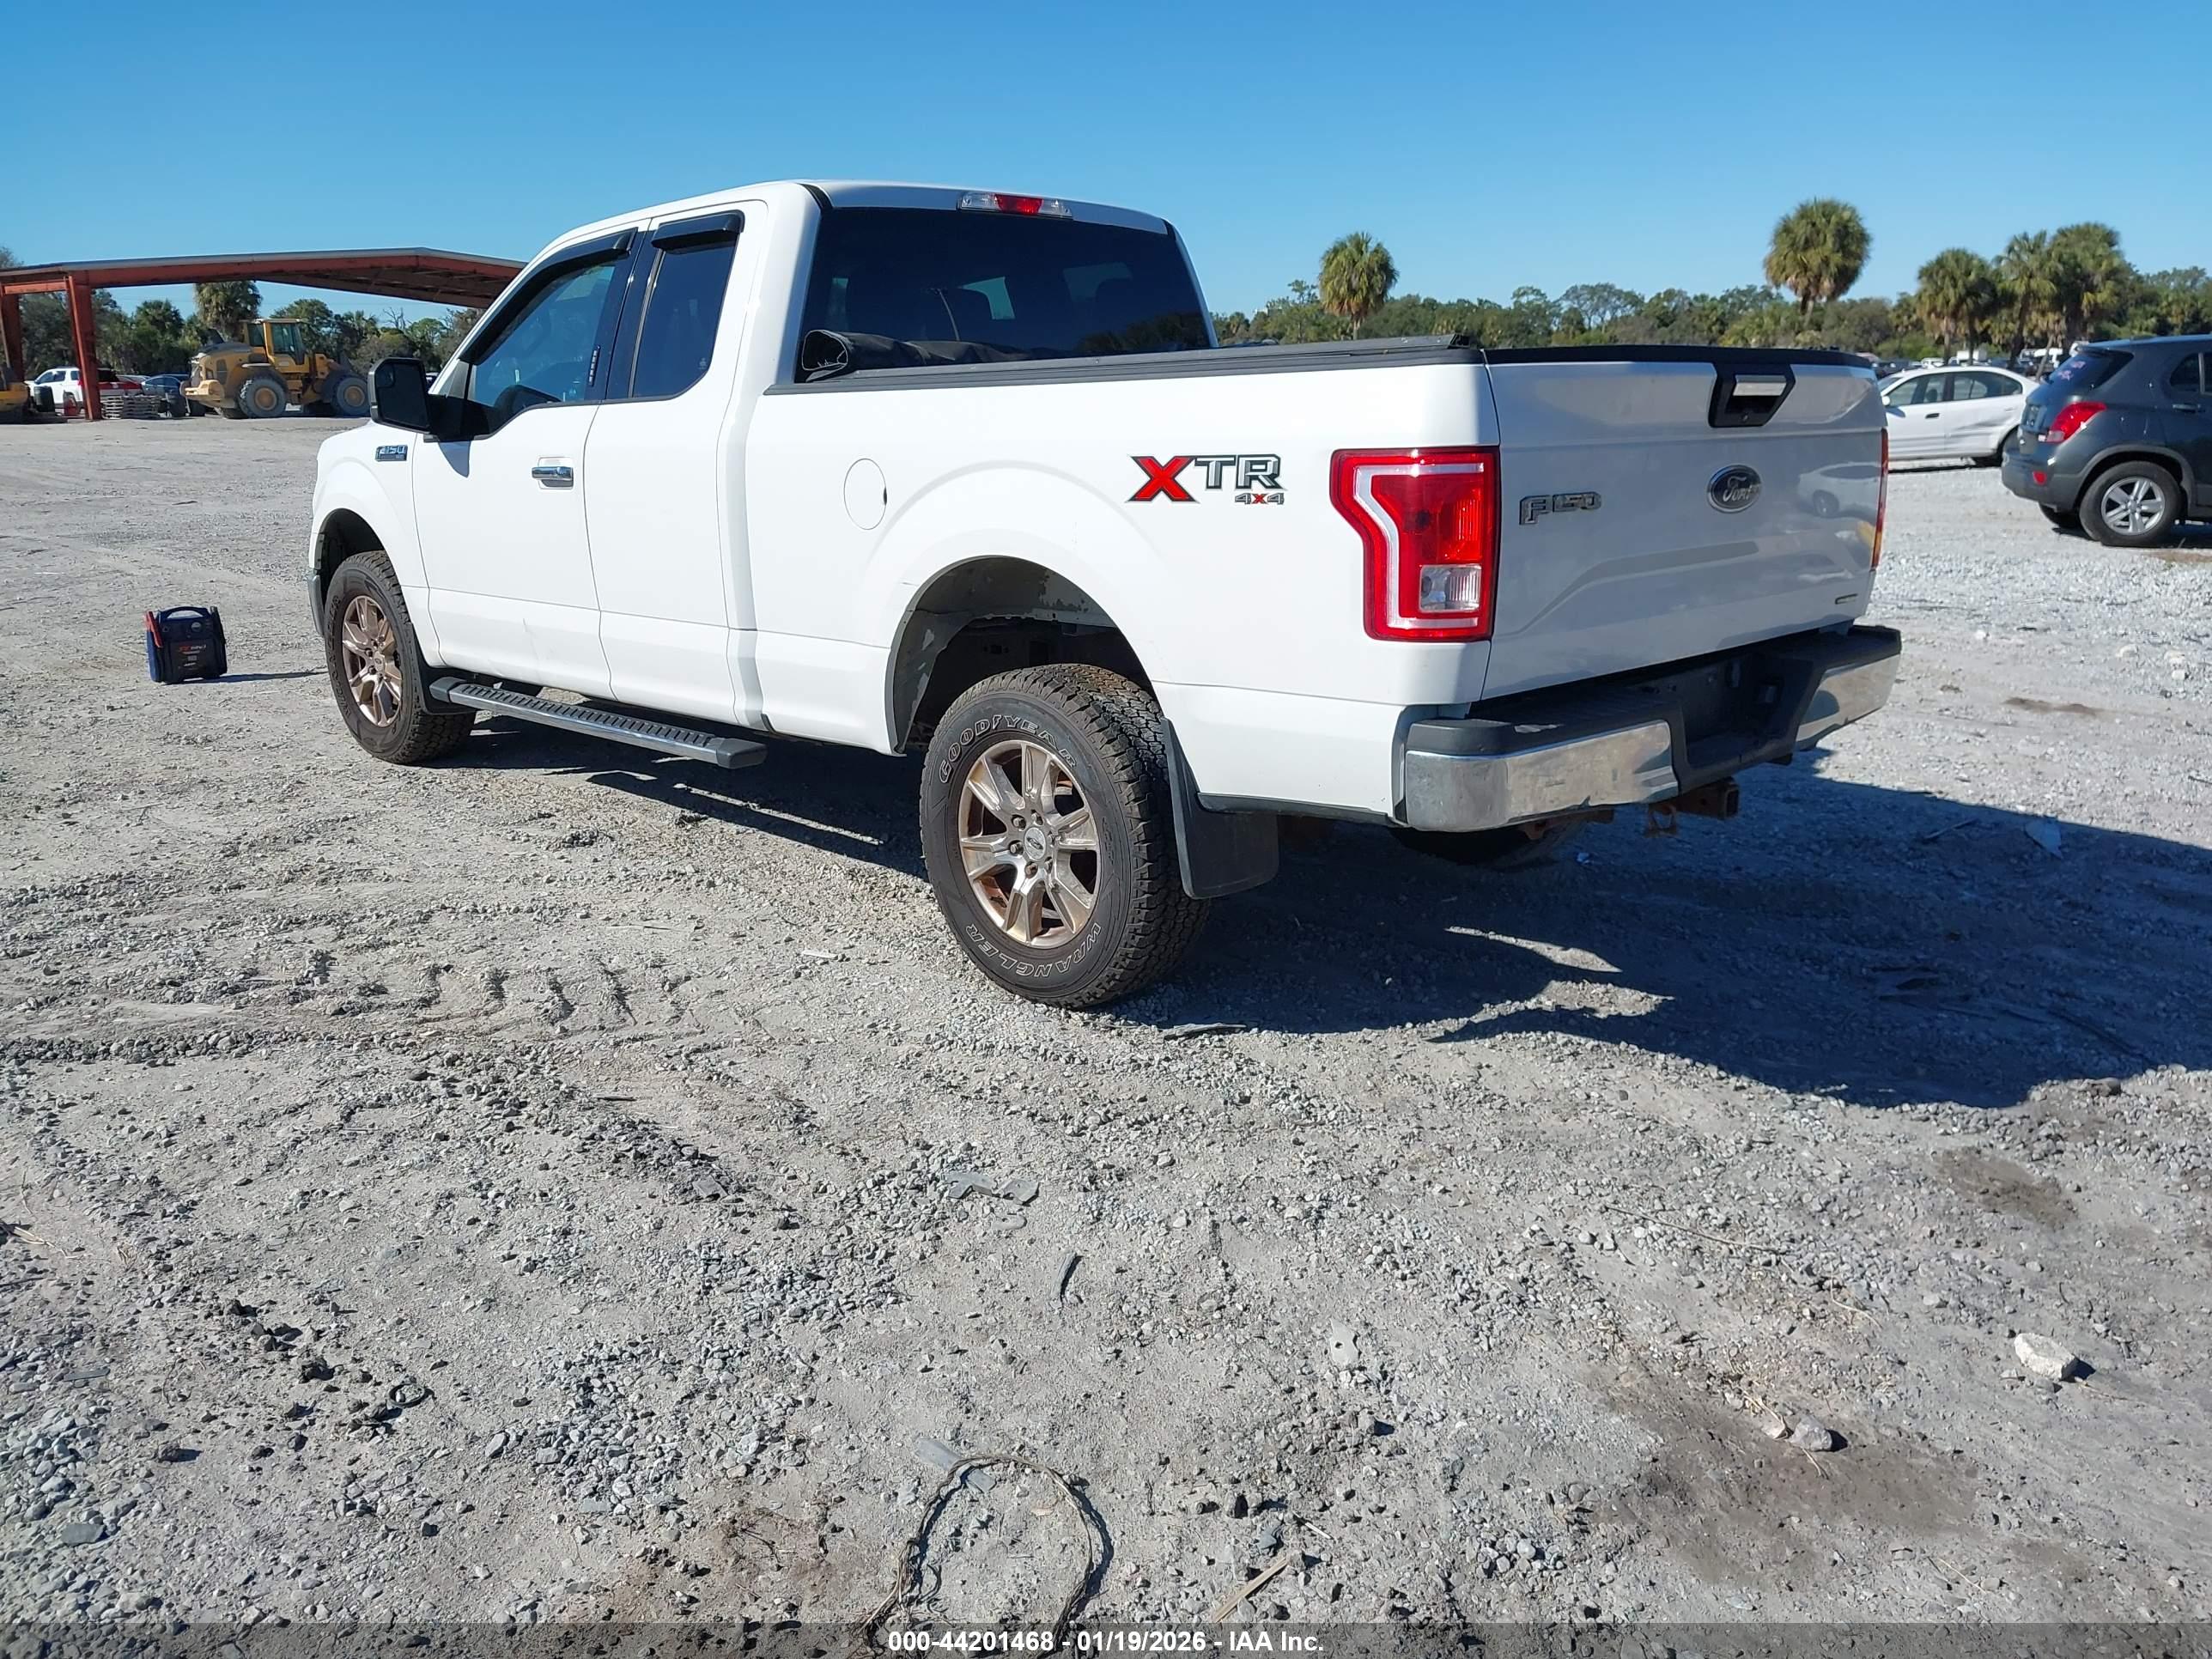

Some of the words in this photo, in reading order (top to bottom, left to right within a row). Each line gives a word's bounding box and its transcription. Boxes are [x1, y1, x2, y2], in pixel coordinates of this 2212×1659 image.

[1125, 453, 1286, 503] XTR
[939, 714, 1078, 784] GOODYEAR
[964, 923, 1102, 978] WRANGLER
